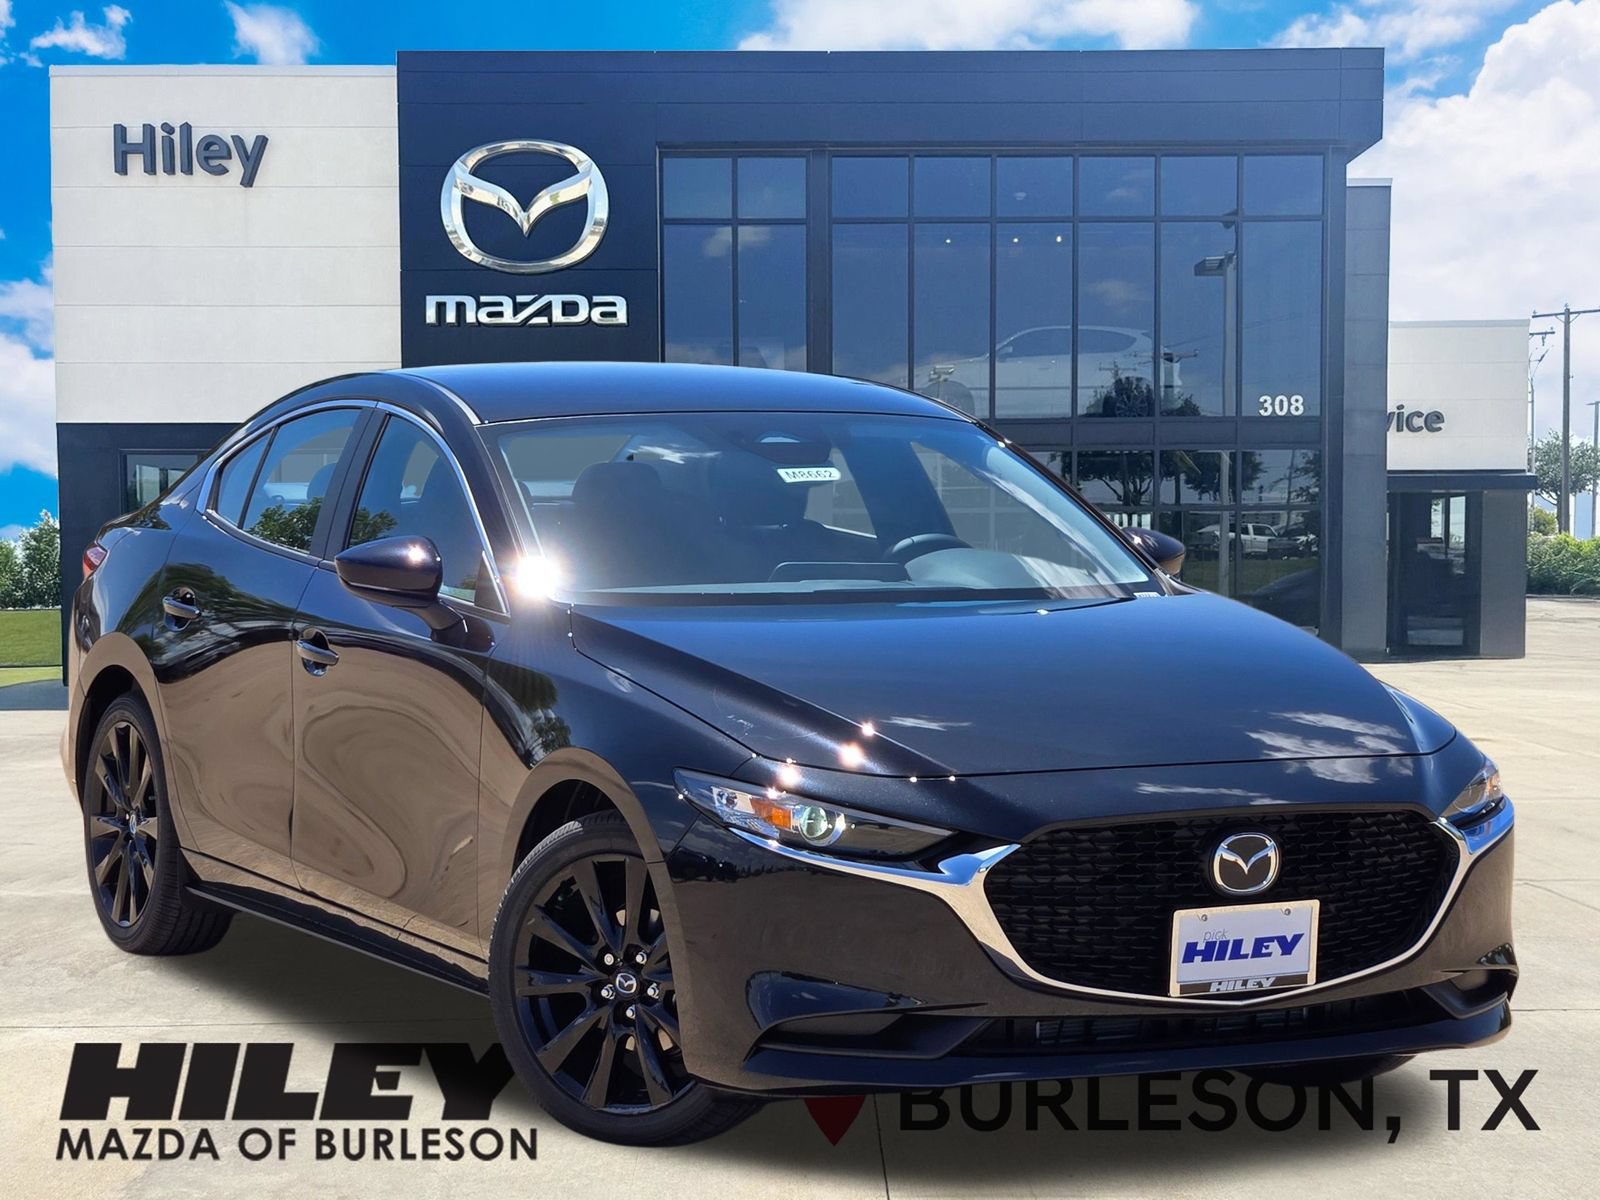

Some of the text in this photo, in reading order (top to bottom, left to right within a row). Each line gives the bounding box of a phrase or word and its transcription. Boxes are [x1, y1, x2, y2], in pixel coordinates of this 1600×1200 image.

[113, 121, 269, 188] Hiley
[1258, 394, 1304, 416] 308
[1203, 928, 1229, 942] pick
[1182, 932, 1305, 964] HILEY
[1209, 977, 1277, 993] HILEY
